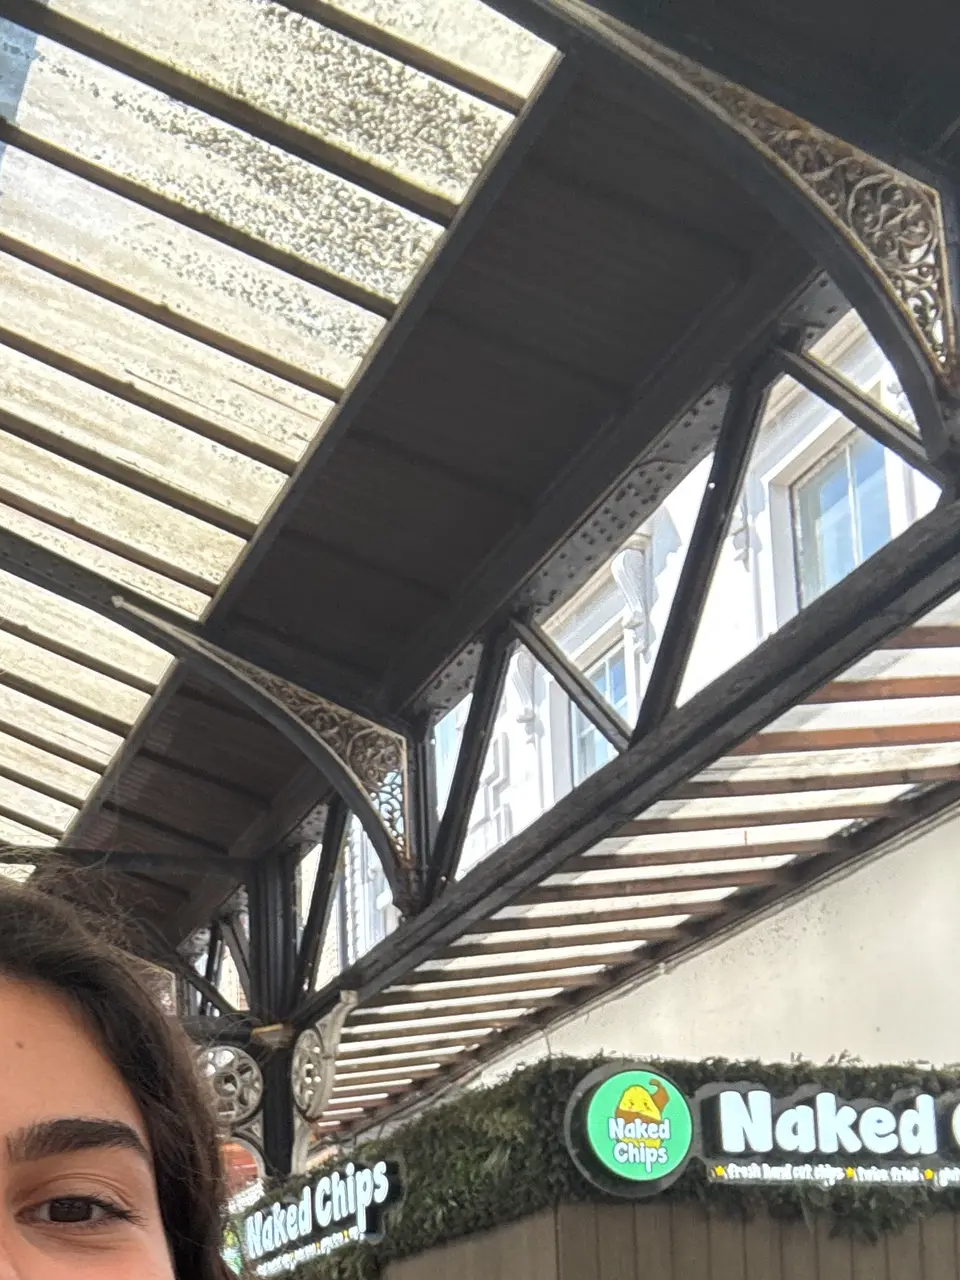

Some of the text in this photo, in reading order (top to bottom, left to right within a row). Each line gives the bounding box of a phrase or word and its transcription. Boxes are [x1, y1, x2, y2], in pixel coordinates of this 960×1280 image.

[608, 1117, 671, 1140] Naked
[720, 1090, 938, 1155] Naked
[613, 1141, 669, 1173] Chips
[245, 1186, 312, 1259] Naked
[315, 1160, 389, 1233] Chips
